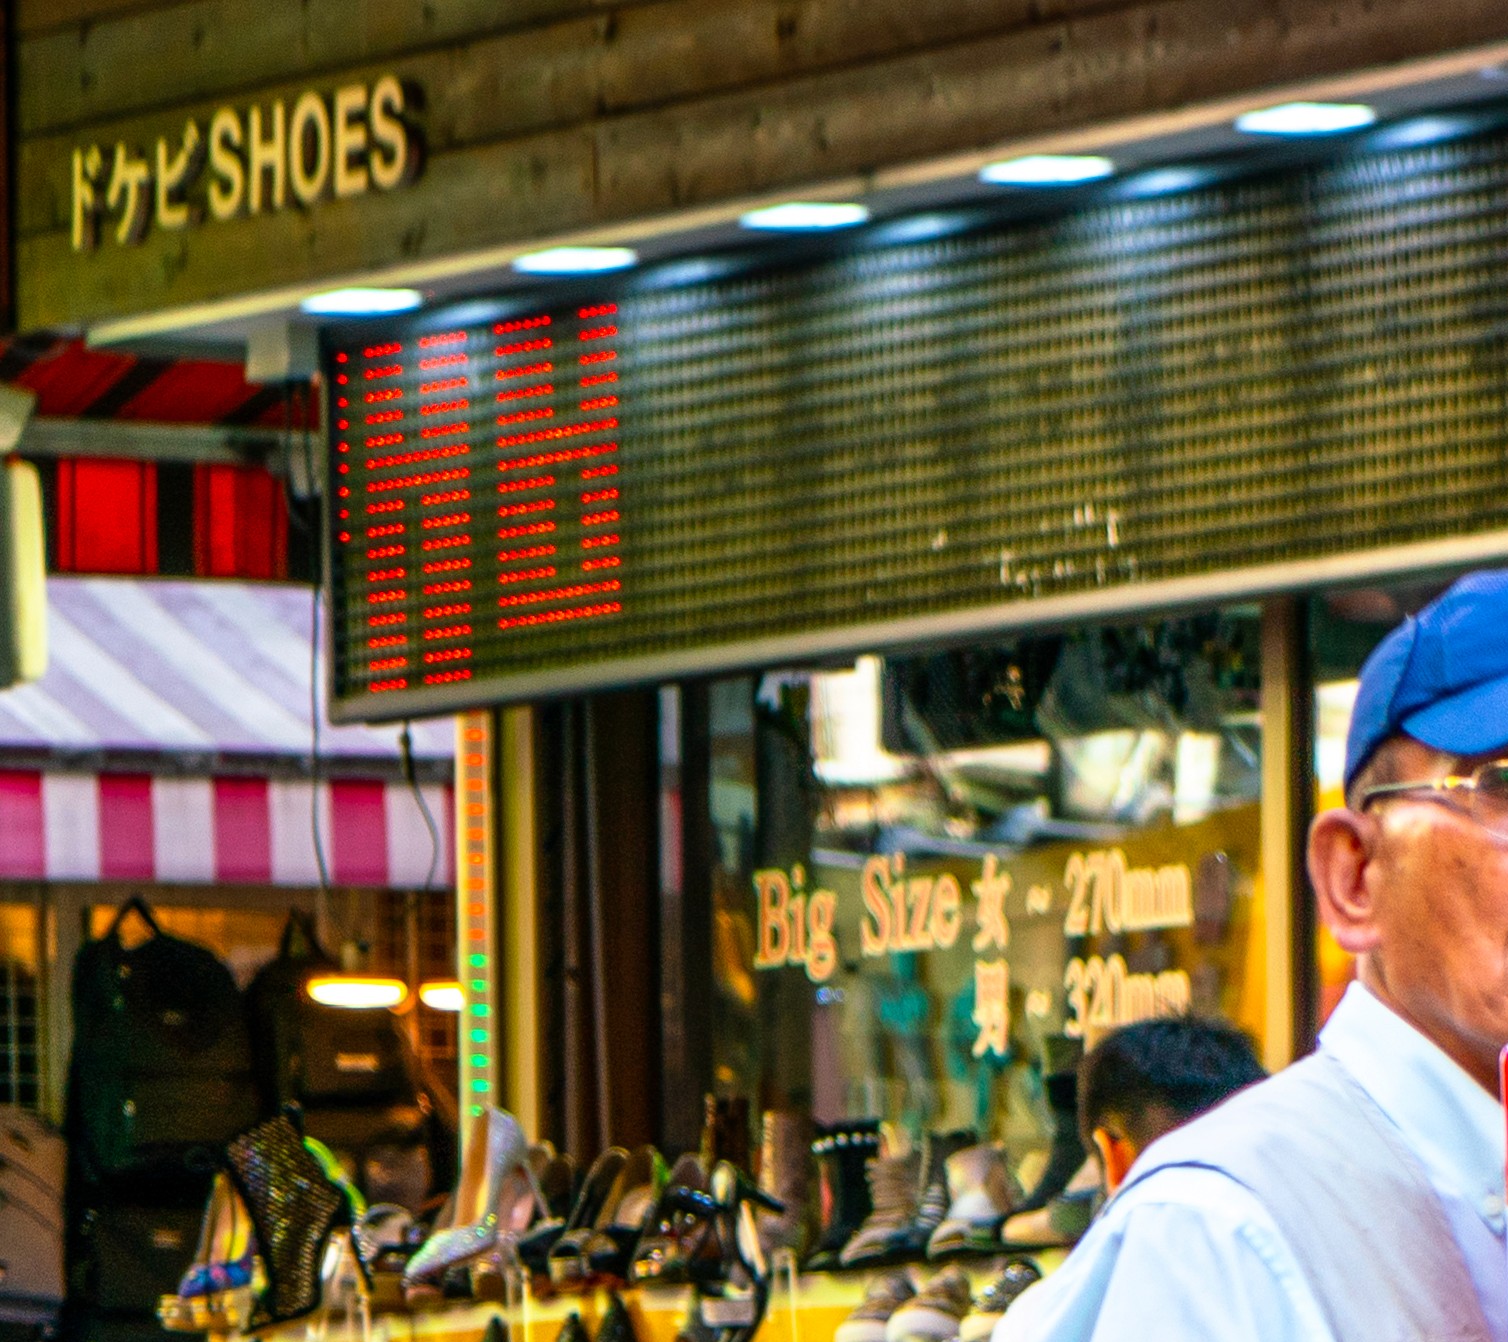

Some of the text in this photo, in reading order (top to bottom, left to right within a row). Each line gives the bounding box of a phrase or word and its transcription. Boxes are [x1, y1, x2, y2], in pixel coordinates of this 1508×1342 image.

[208, 76, 406, 221] SHOES
[752, 865, 840, 980] Big
[858, 850, 964, 958] Size
[1064, 849, 1194, 937] 270mm
